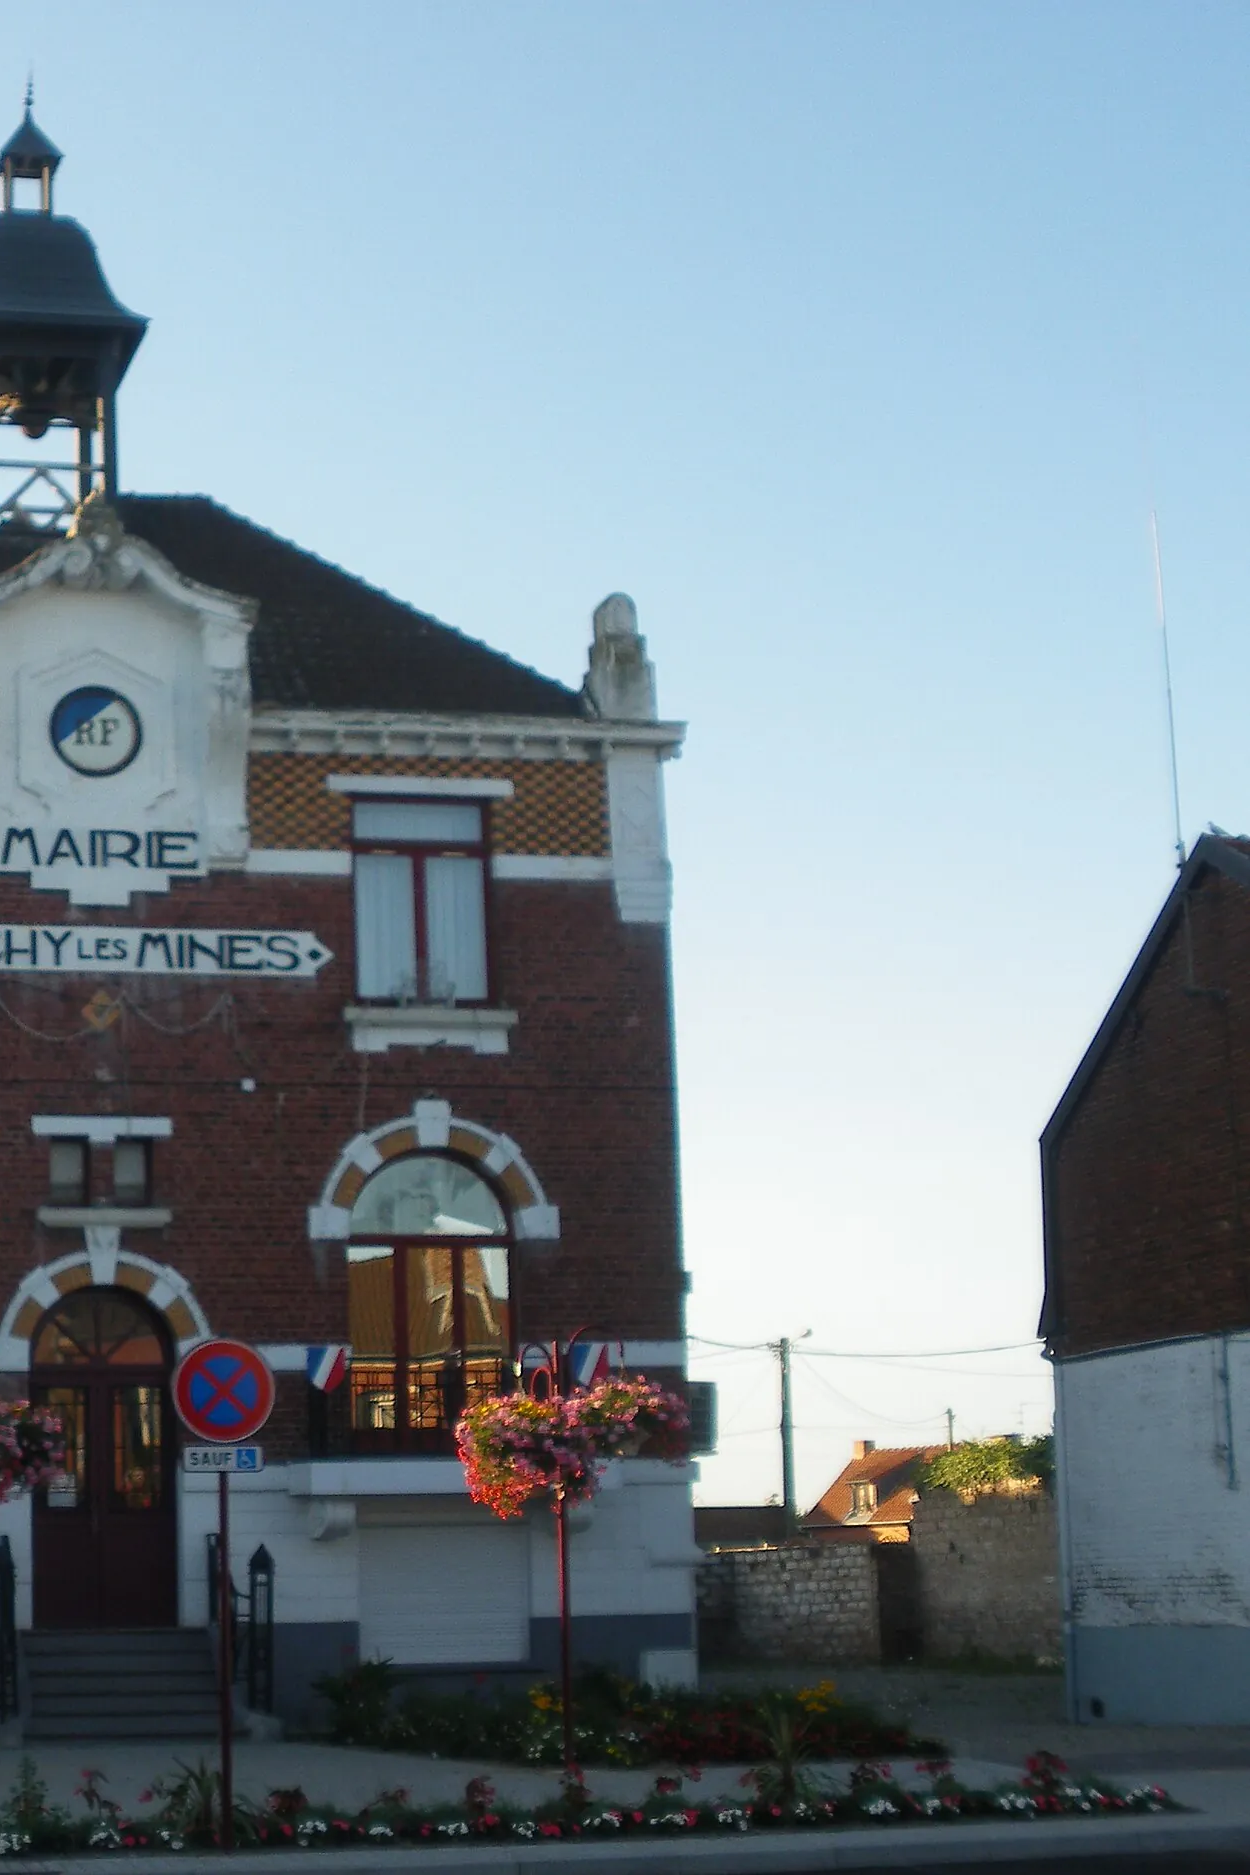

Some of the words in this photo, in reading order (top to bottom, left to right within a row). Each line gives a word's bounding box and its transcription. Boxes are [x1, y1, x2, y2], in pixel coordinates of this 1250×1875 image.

[73, 717, 119, 746] RF
[1, 826, 199, 869] MAIRIE
[77, 938, 128, 961] LES
[135, 932, 301, 971] MINES
[190, 1452, 232, 1466] SAUF
